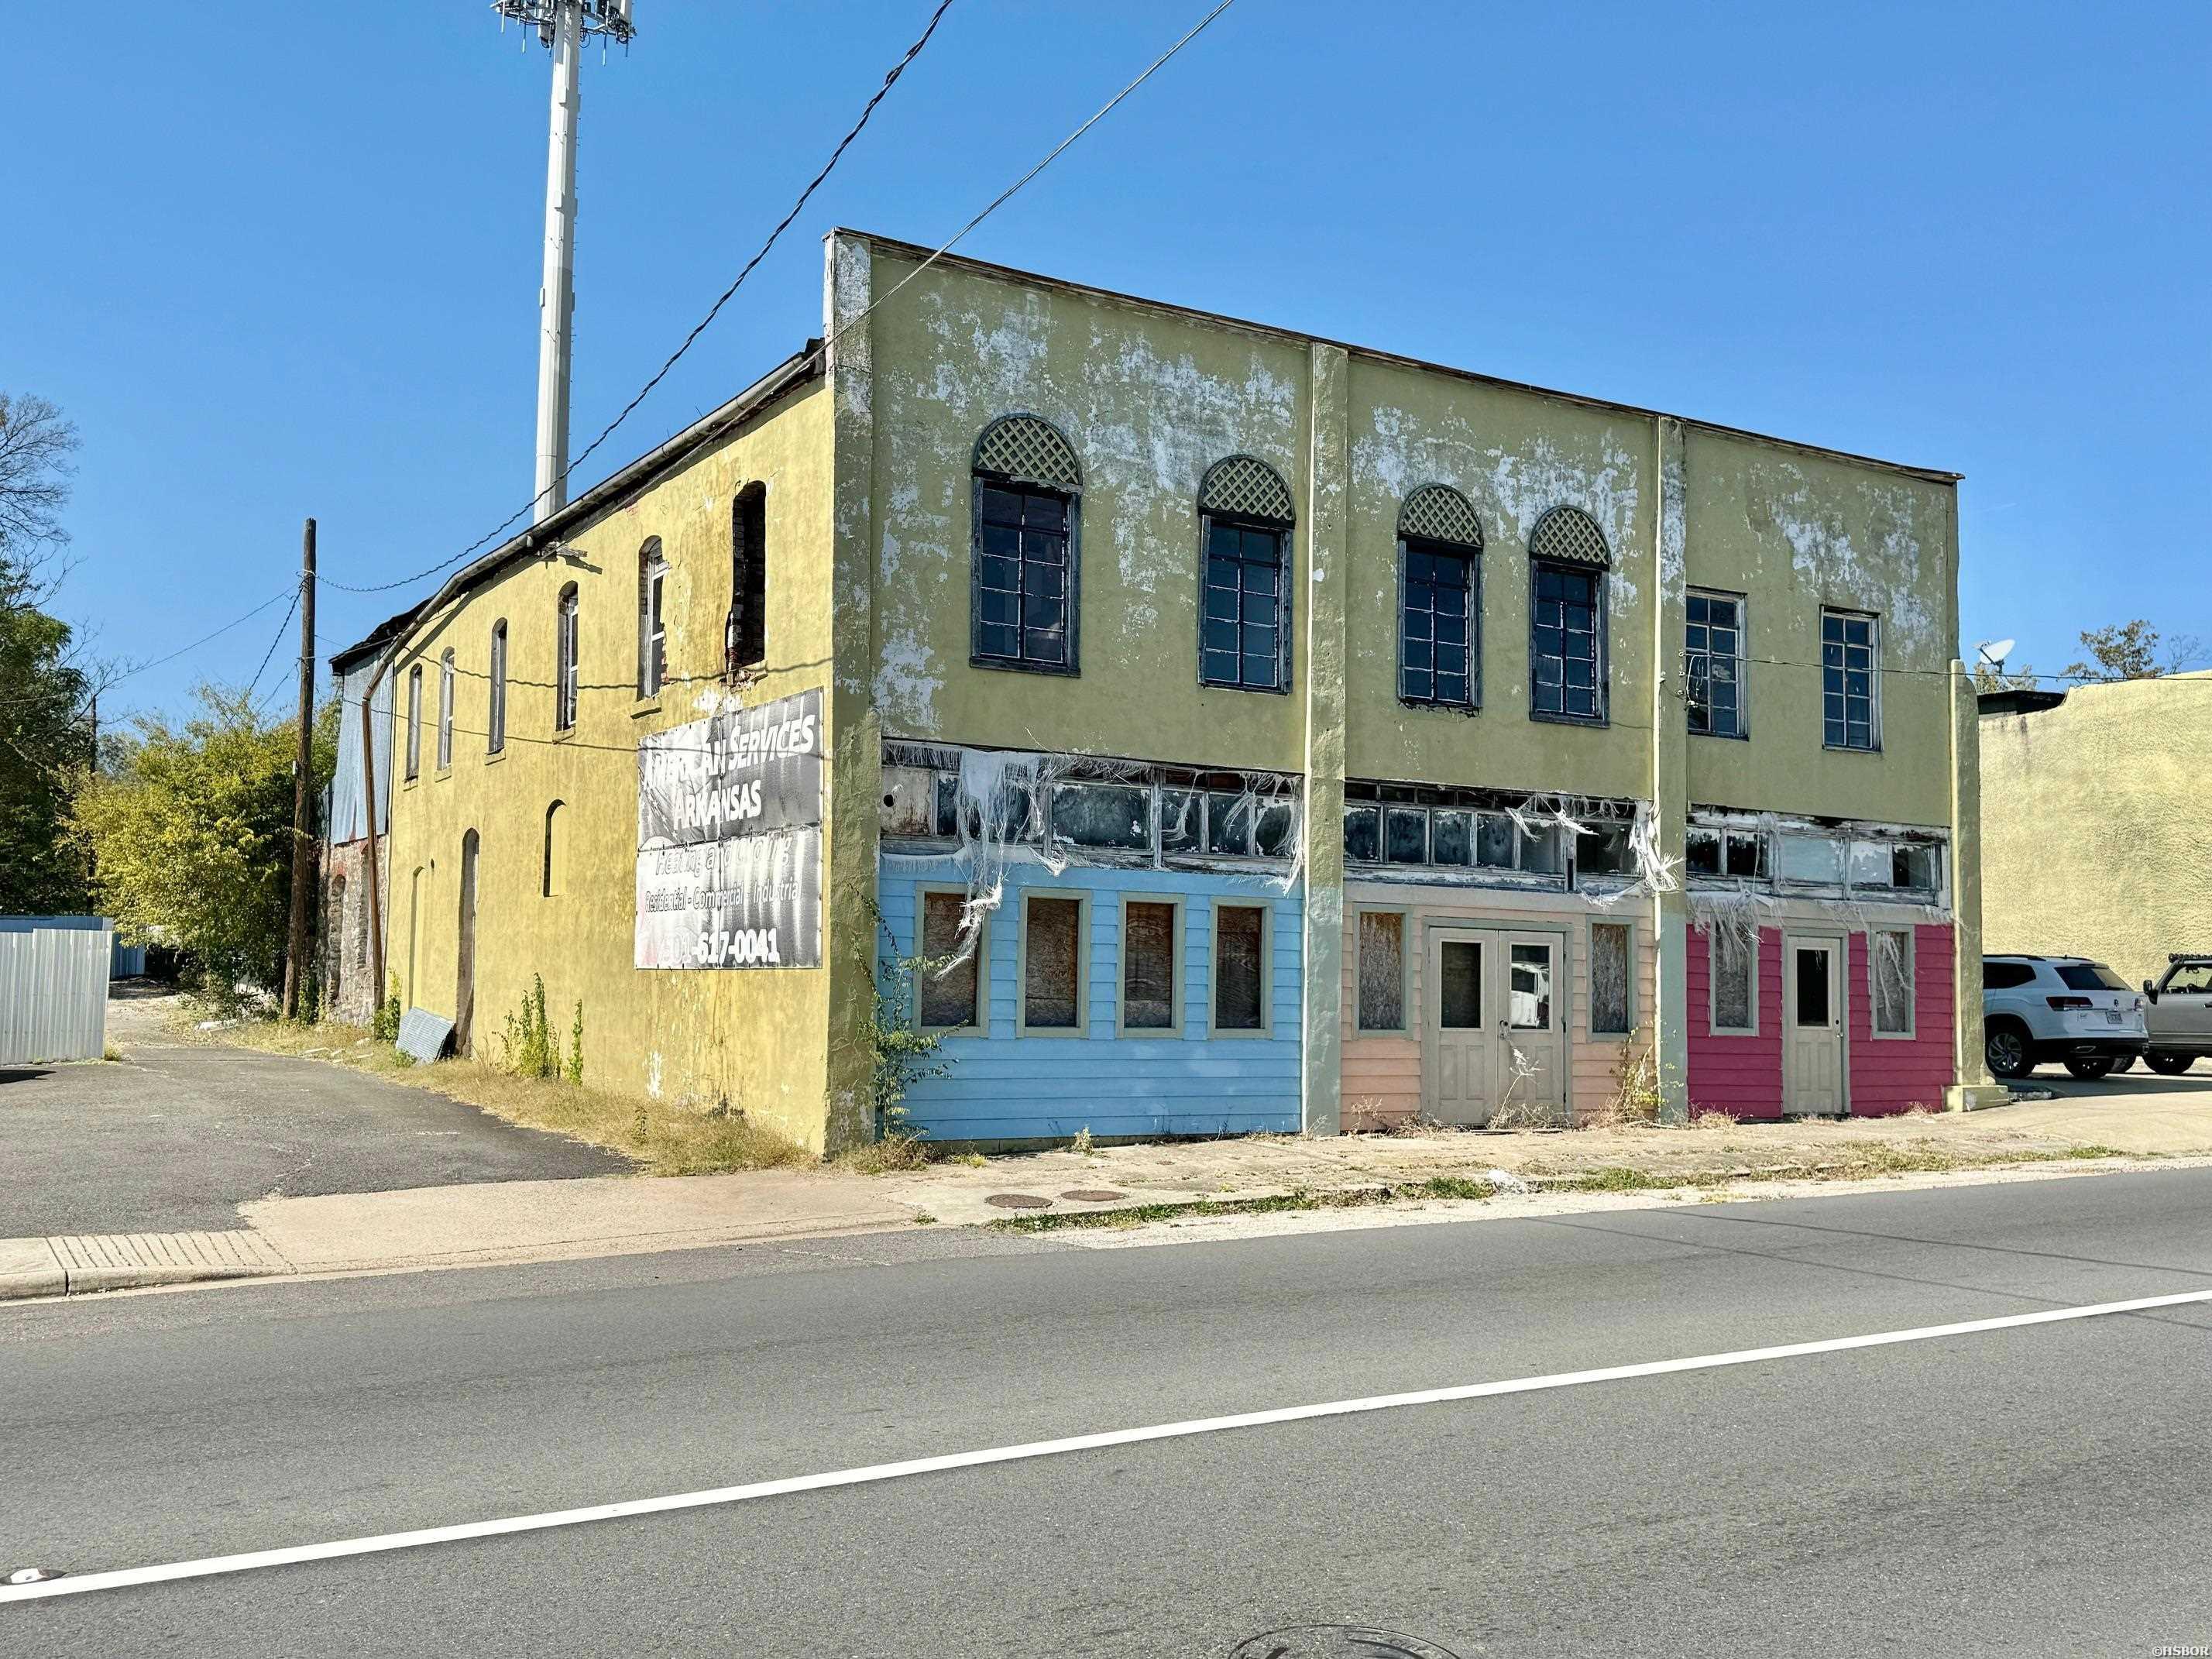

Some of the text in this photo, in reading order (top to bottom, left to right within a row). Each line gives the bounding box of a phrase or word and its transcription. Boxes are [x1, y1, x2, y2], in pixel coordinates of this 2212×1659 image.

[644, 714, 816, 791] AMERCAN SERVICES
[674, 779, 762, 830] ARKANSAS
[706, 839, 735, 870] ad
[645, 886, 687, 912] Residential
[692, 881, 744, 910] Commercial
[658, 928, 781, 964] 01-617-0041
